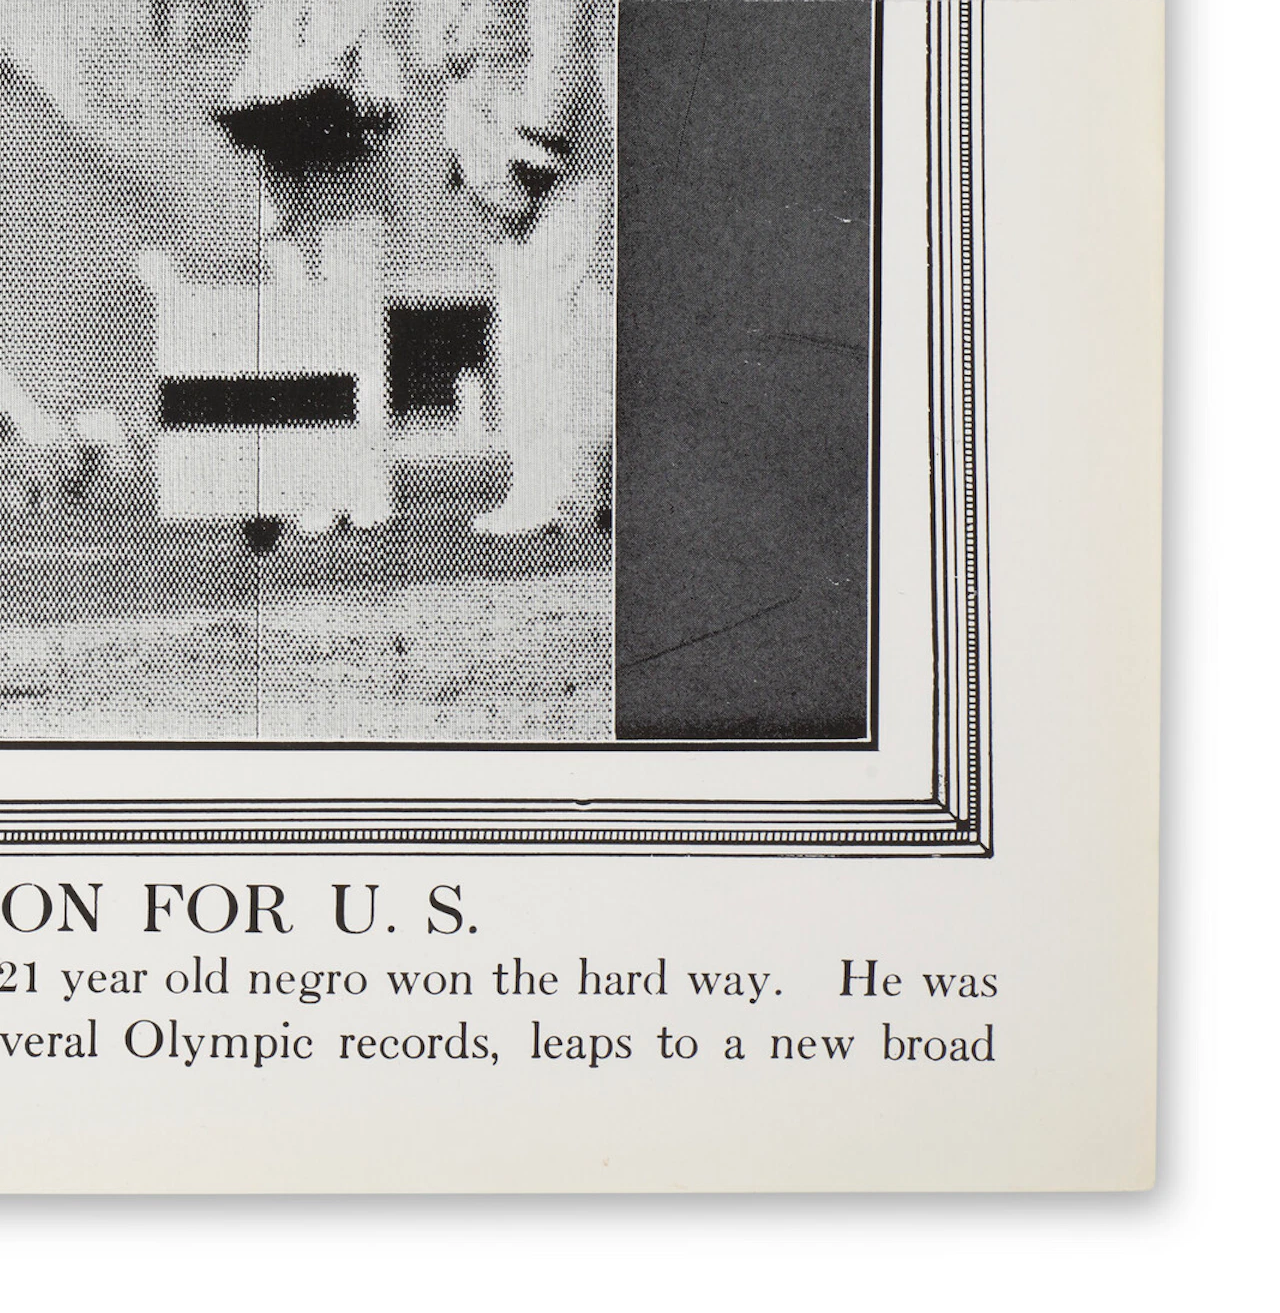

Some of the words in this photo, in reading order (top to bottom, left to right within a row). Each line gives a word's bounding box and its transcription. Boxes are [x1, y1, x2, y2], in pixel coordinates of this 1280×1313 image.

[143, 883, 294, 934] FOR
[331, 884, 395, 935] U.
[427, 884, 478, 935] S.
[61, 969, 148, 1002] year
[165, 955, 229, 994] old
[249, 970, 368, 1004] negro
[386, 971, 473, 996] won
[492, 957, 558, 996] the
[578, 957, 668, 996] hard
[687, 972, 782, 1005] way.
[839, 959, 902, 997] He
[922, 974, 998, 998] was
[124, 1019, 313, 1069] Olympic
[339, 1021, 499, 1066] records,
[531, 1020, 632, 1069] leaps
[656, 1026, 698, 1059] to
[724, 1035, 746, 1060] a
[770, 1035, 855, 1060] new
[882, 1022, 996, 1062] broad
